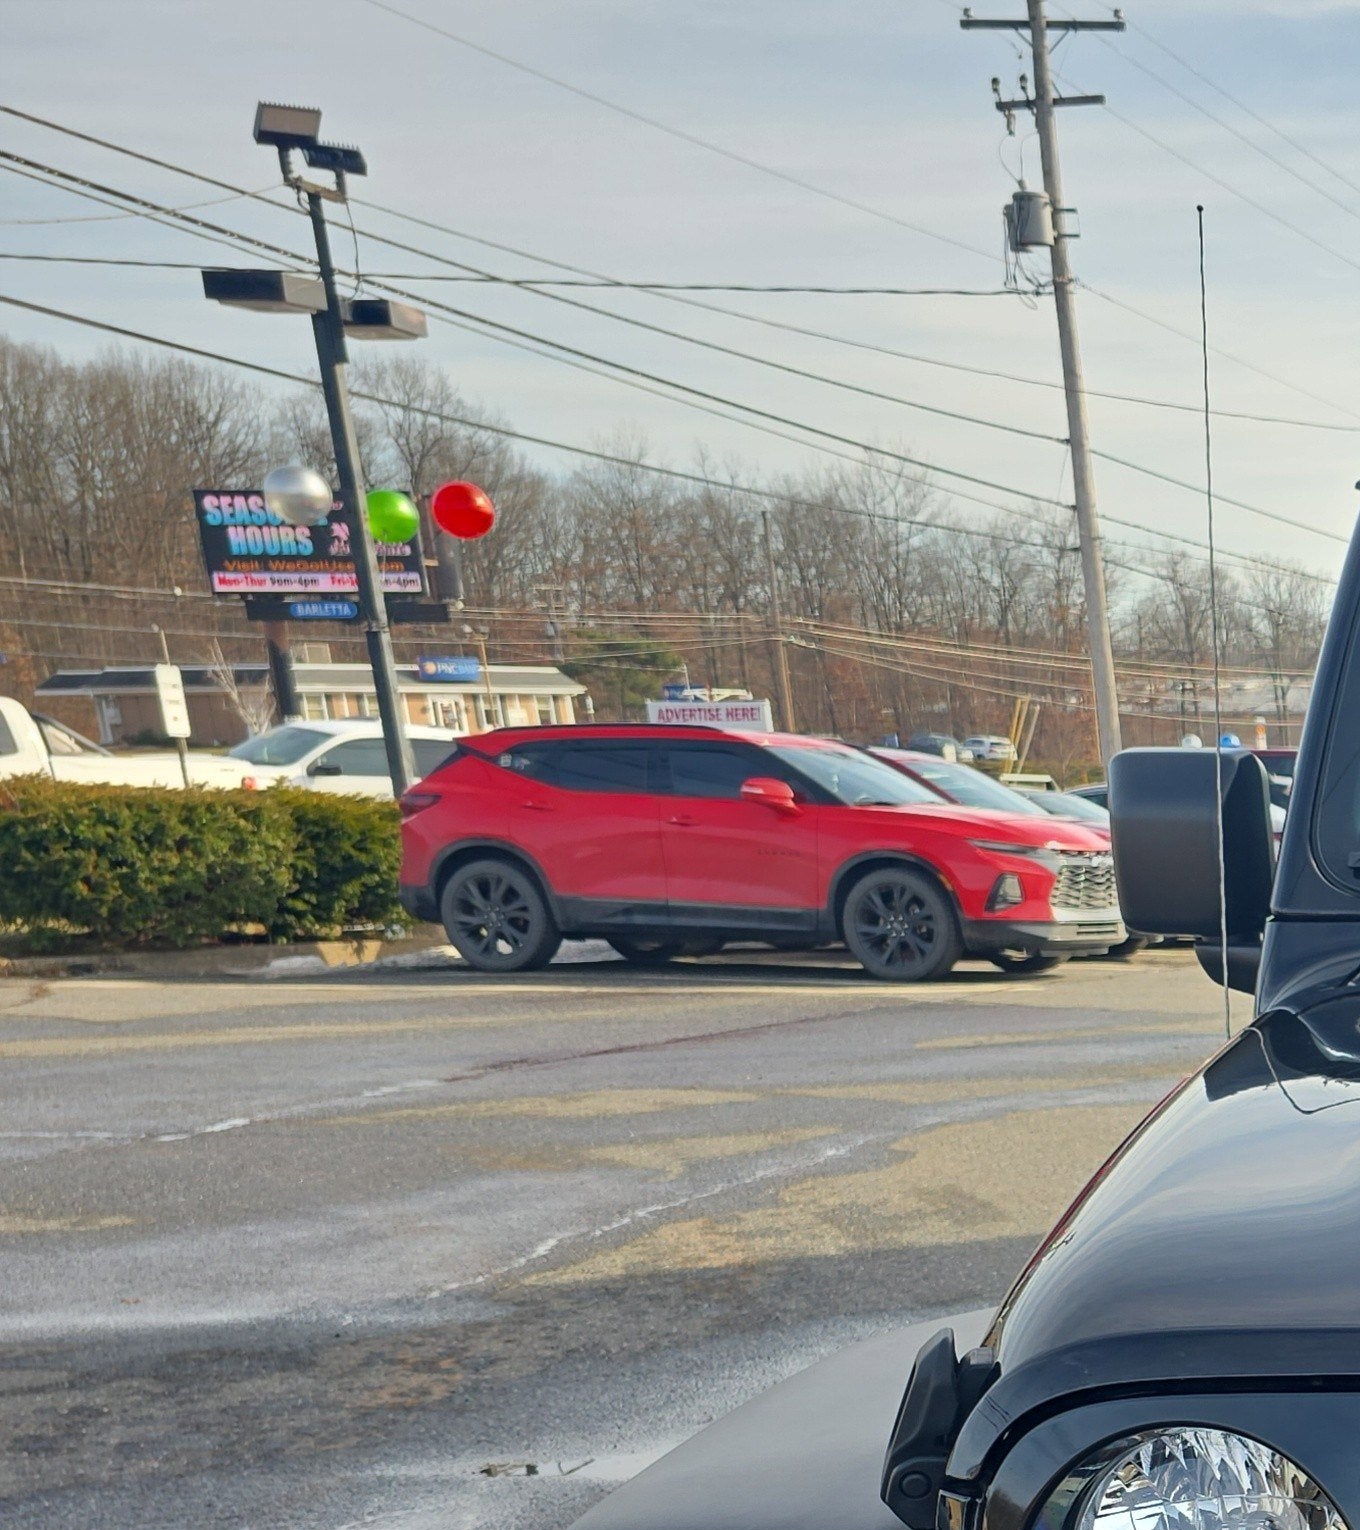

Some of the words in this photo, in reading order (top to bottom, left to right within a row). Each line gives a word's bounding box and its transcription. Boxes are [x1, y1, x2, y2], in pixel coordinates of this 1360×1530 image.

[203, 494, 328, 526] SEAS
[226, 525, 314, 556] HOURS
[296, 603, 351, 616] BARLETTA
[657, 707, 722, 722] ADVERTISE
